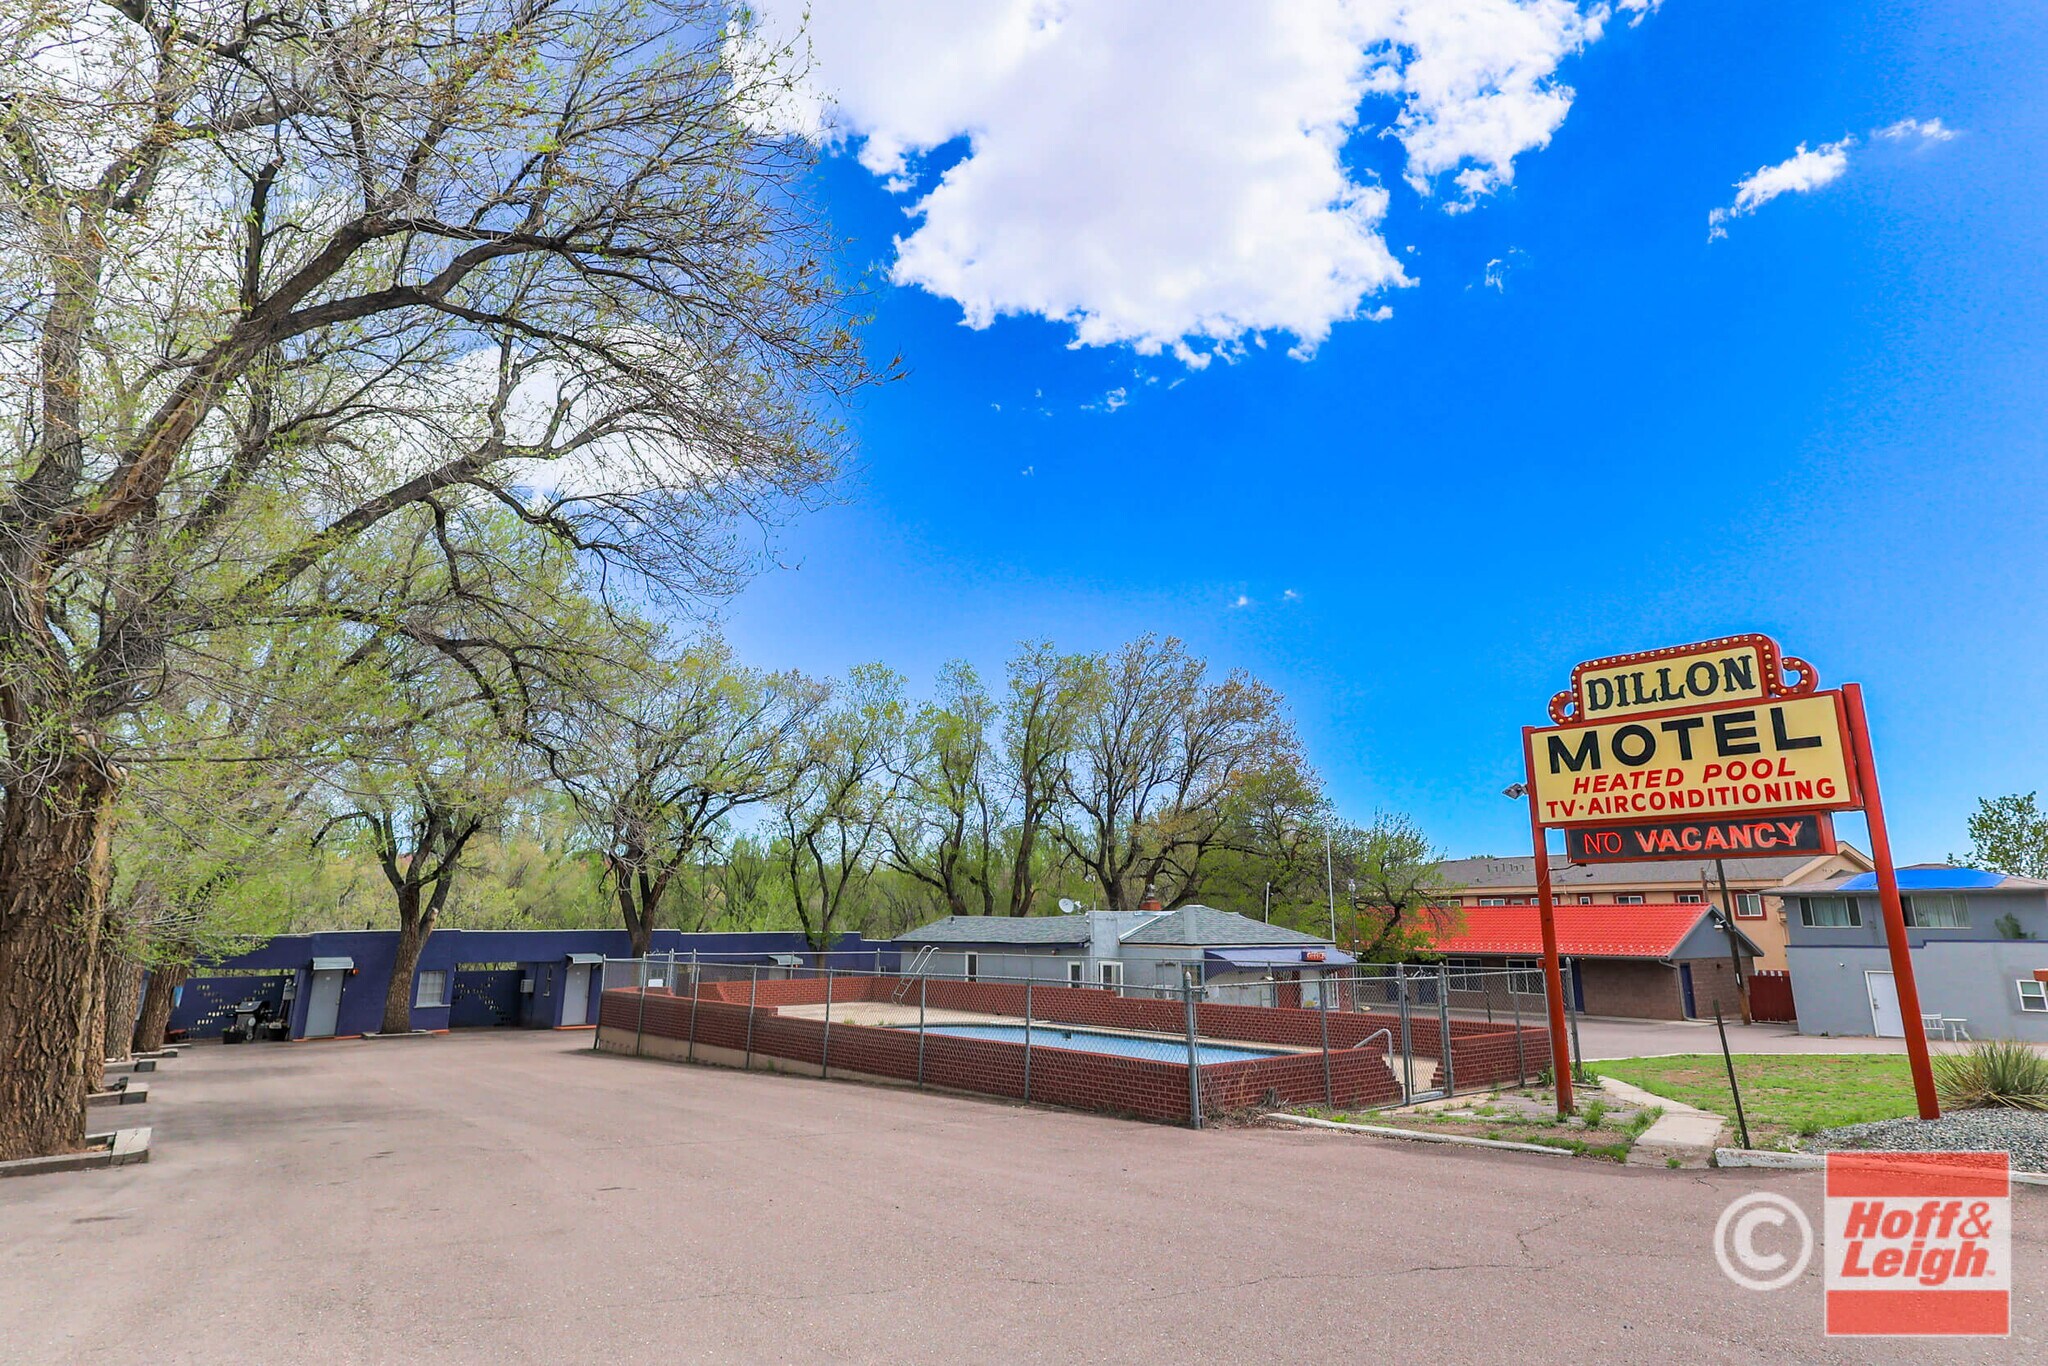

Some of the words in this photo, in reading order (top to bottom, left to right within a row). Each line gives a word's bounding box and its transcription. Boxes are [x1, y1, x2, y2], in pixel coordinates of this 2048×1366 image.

[1586, 655, 1756, 712] DILLON
[1547, 707, 1822, 774] MOTEL
[1573, 768, 1684, 795] HEATED
[1703, 757, 1796, 783] POOL
[1584, 832, 1622, 854] NO
[1634, 821, 1803, 852] VACANCY
